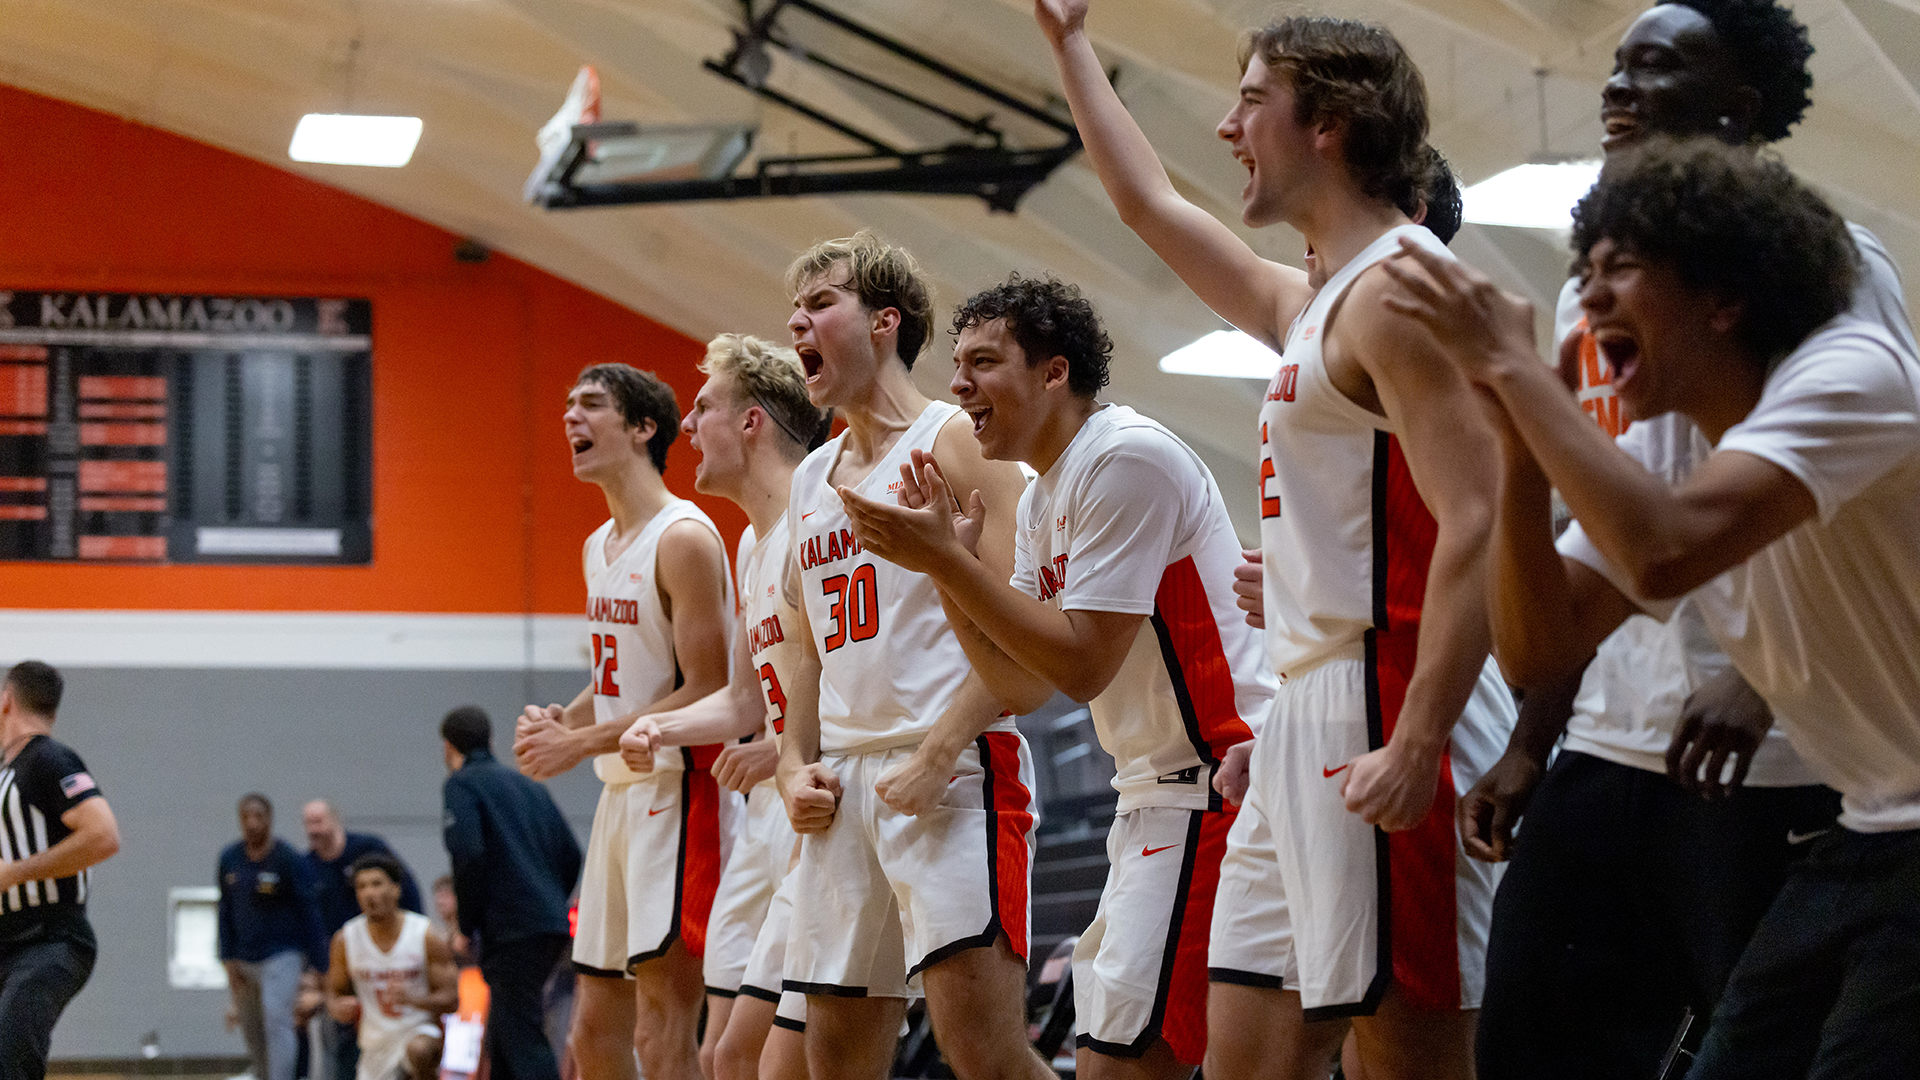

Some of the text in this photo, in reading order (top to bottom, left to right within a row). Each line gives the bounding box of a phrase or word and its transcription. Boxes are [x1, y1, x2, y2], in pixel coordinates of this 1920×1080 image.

[41, 295, 294, 333] KALAMAZOO
[800, 529, 862, 571] KALAM
[822, 563, 879, 653] 30
[756, 662, 787, 735] 3
